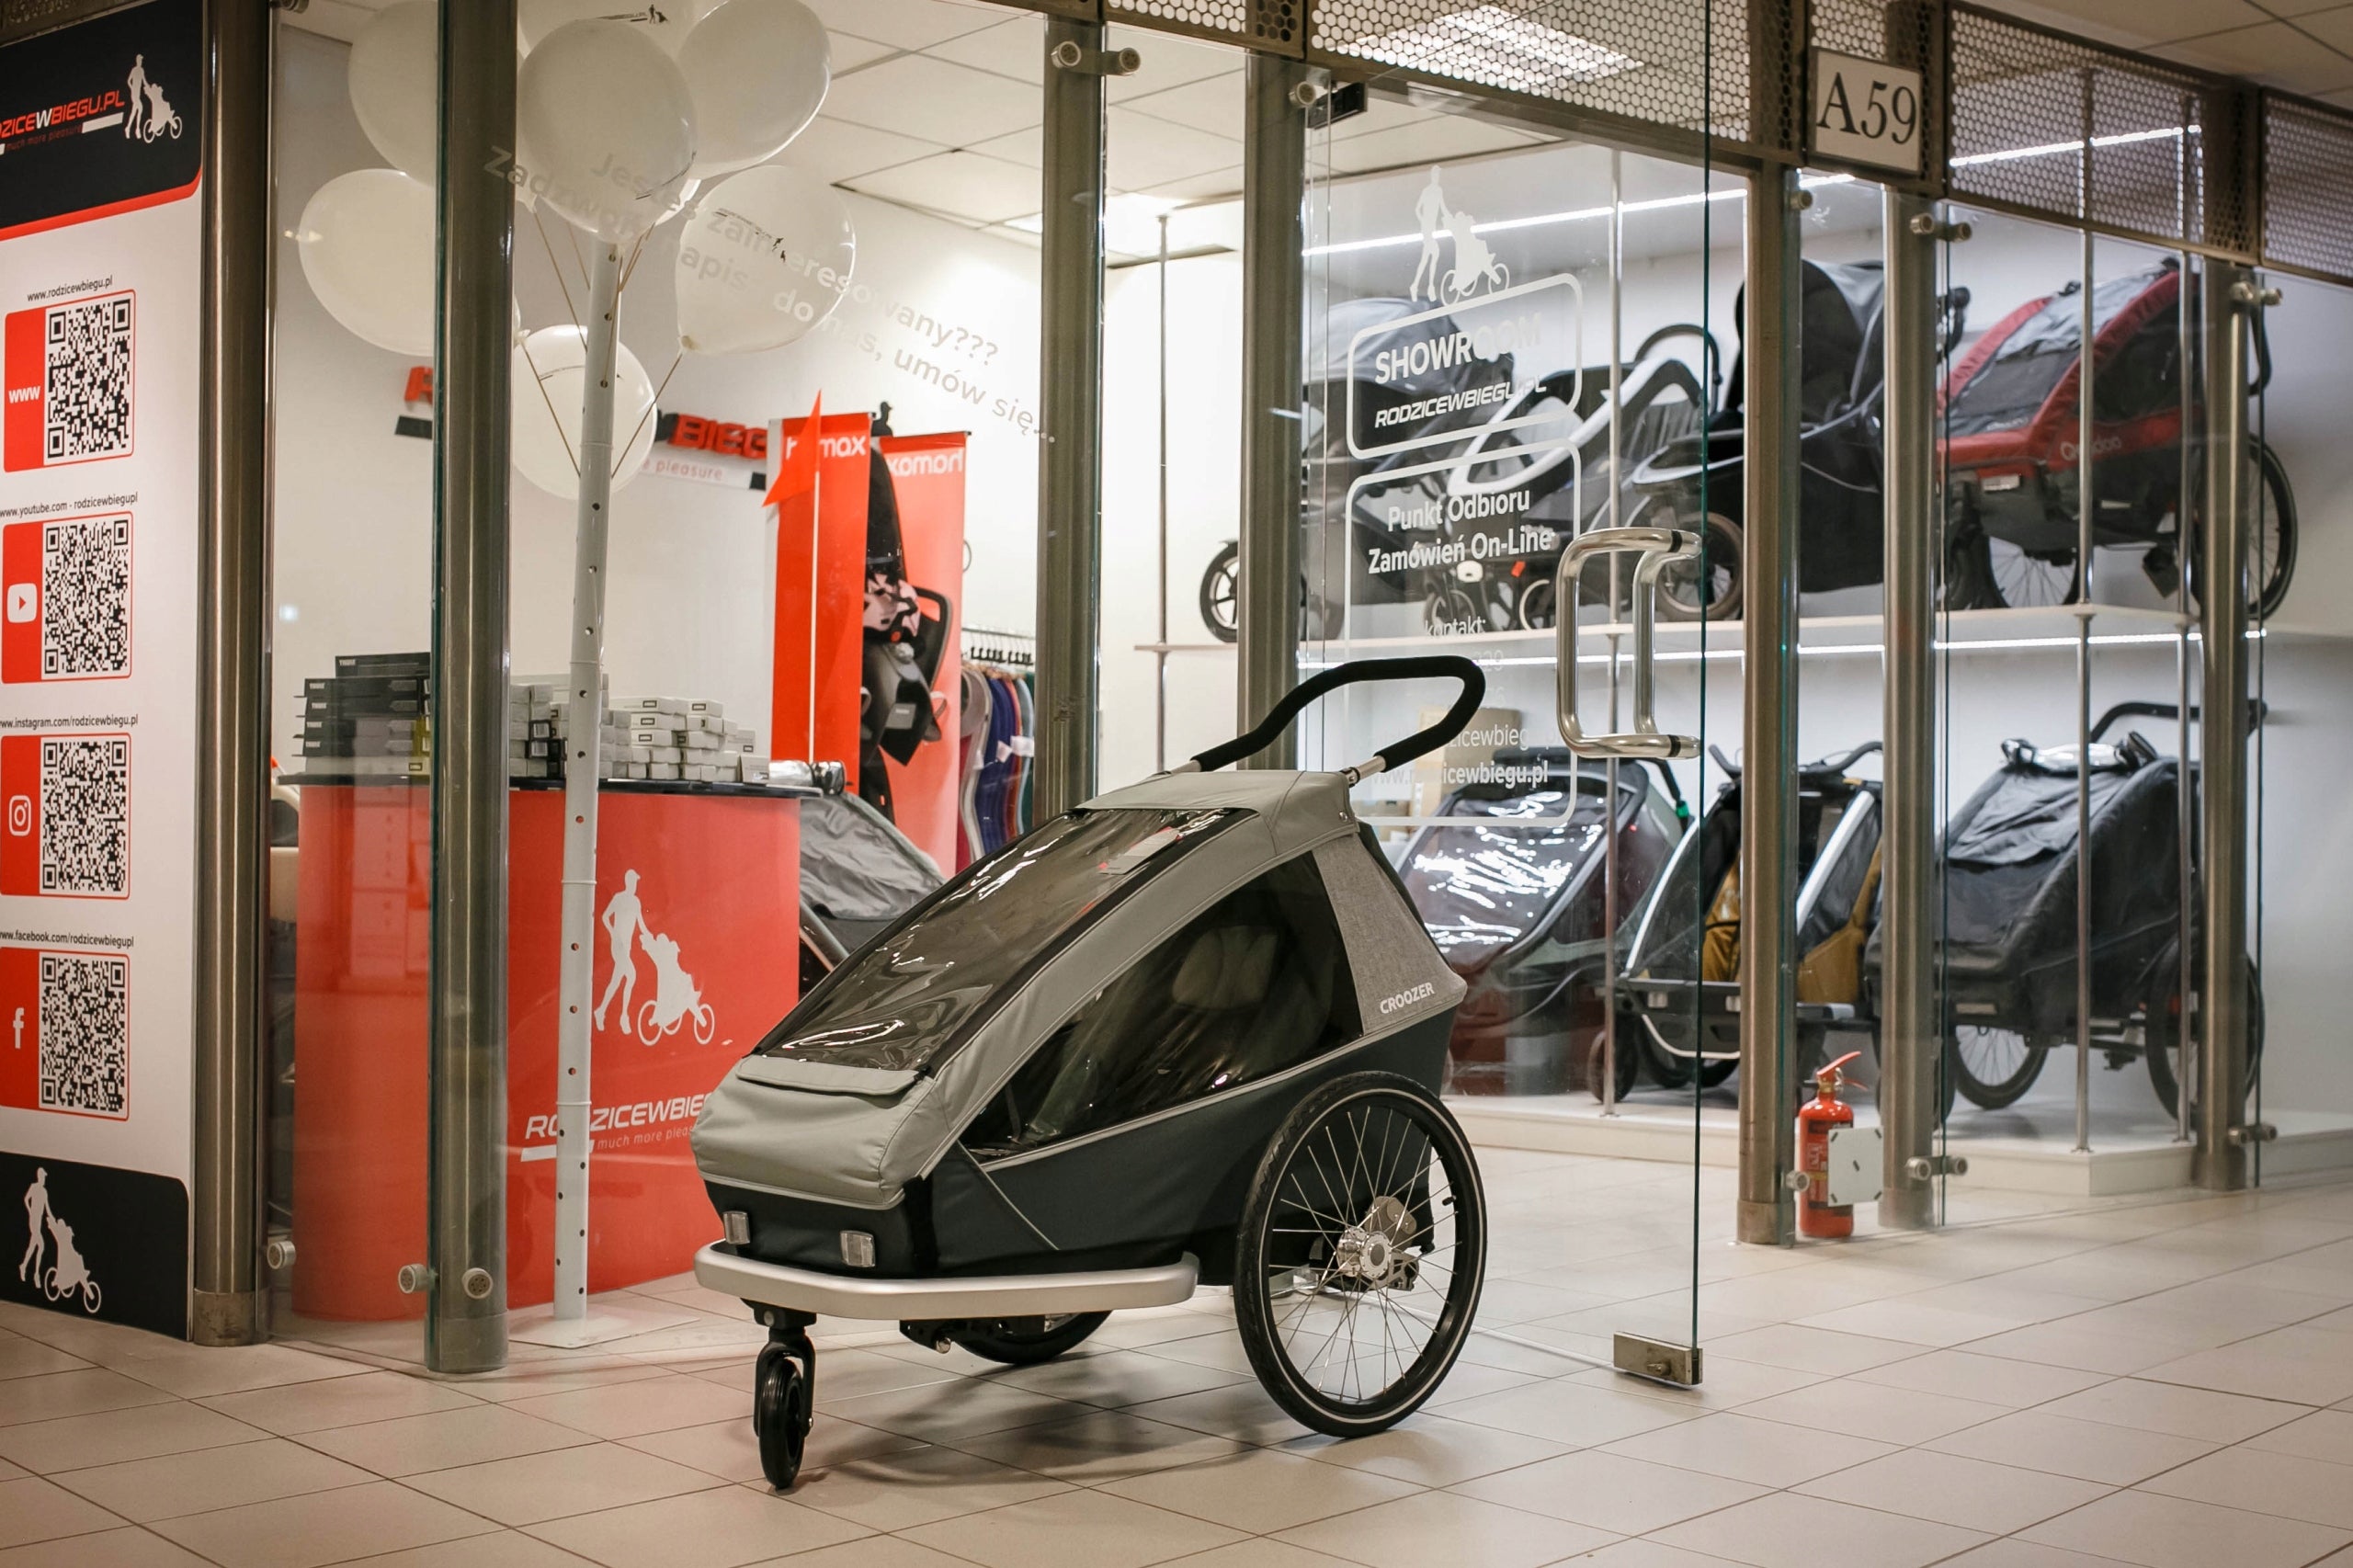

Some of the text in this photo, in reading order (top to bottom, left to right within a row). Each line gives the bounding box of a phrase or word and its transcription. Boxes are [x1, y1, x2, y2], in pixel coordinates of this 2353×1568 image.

[0, 90, 125, 140] ZICEWBIEGU.PL
[1816, 72, 1917, 145] A59
[27, 274, 113, 301] www.rodzicewbiegu.pl
[773, 287, 814, 324] do
[893, 347, 988, 405] umów
[1375, 312, 1543, 384] SHOWROOM
[74, 491, 138, 509] rodzicewbiegupl
[1388, 490, 1530, 532] Punkt Odbioru
[1369, 534, 1465, 574] Zamówień
[1380, 982, 1436, 1014] CROOZER
[597, 1136, 630, 1150] much
[633, 1131, 662, 1145] more
